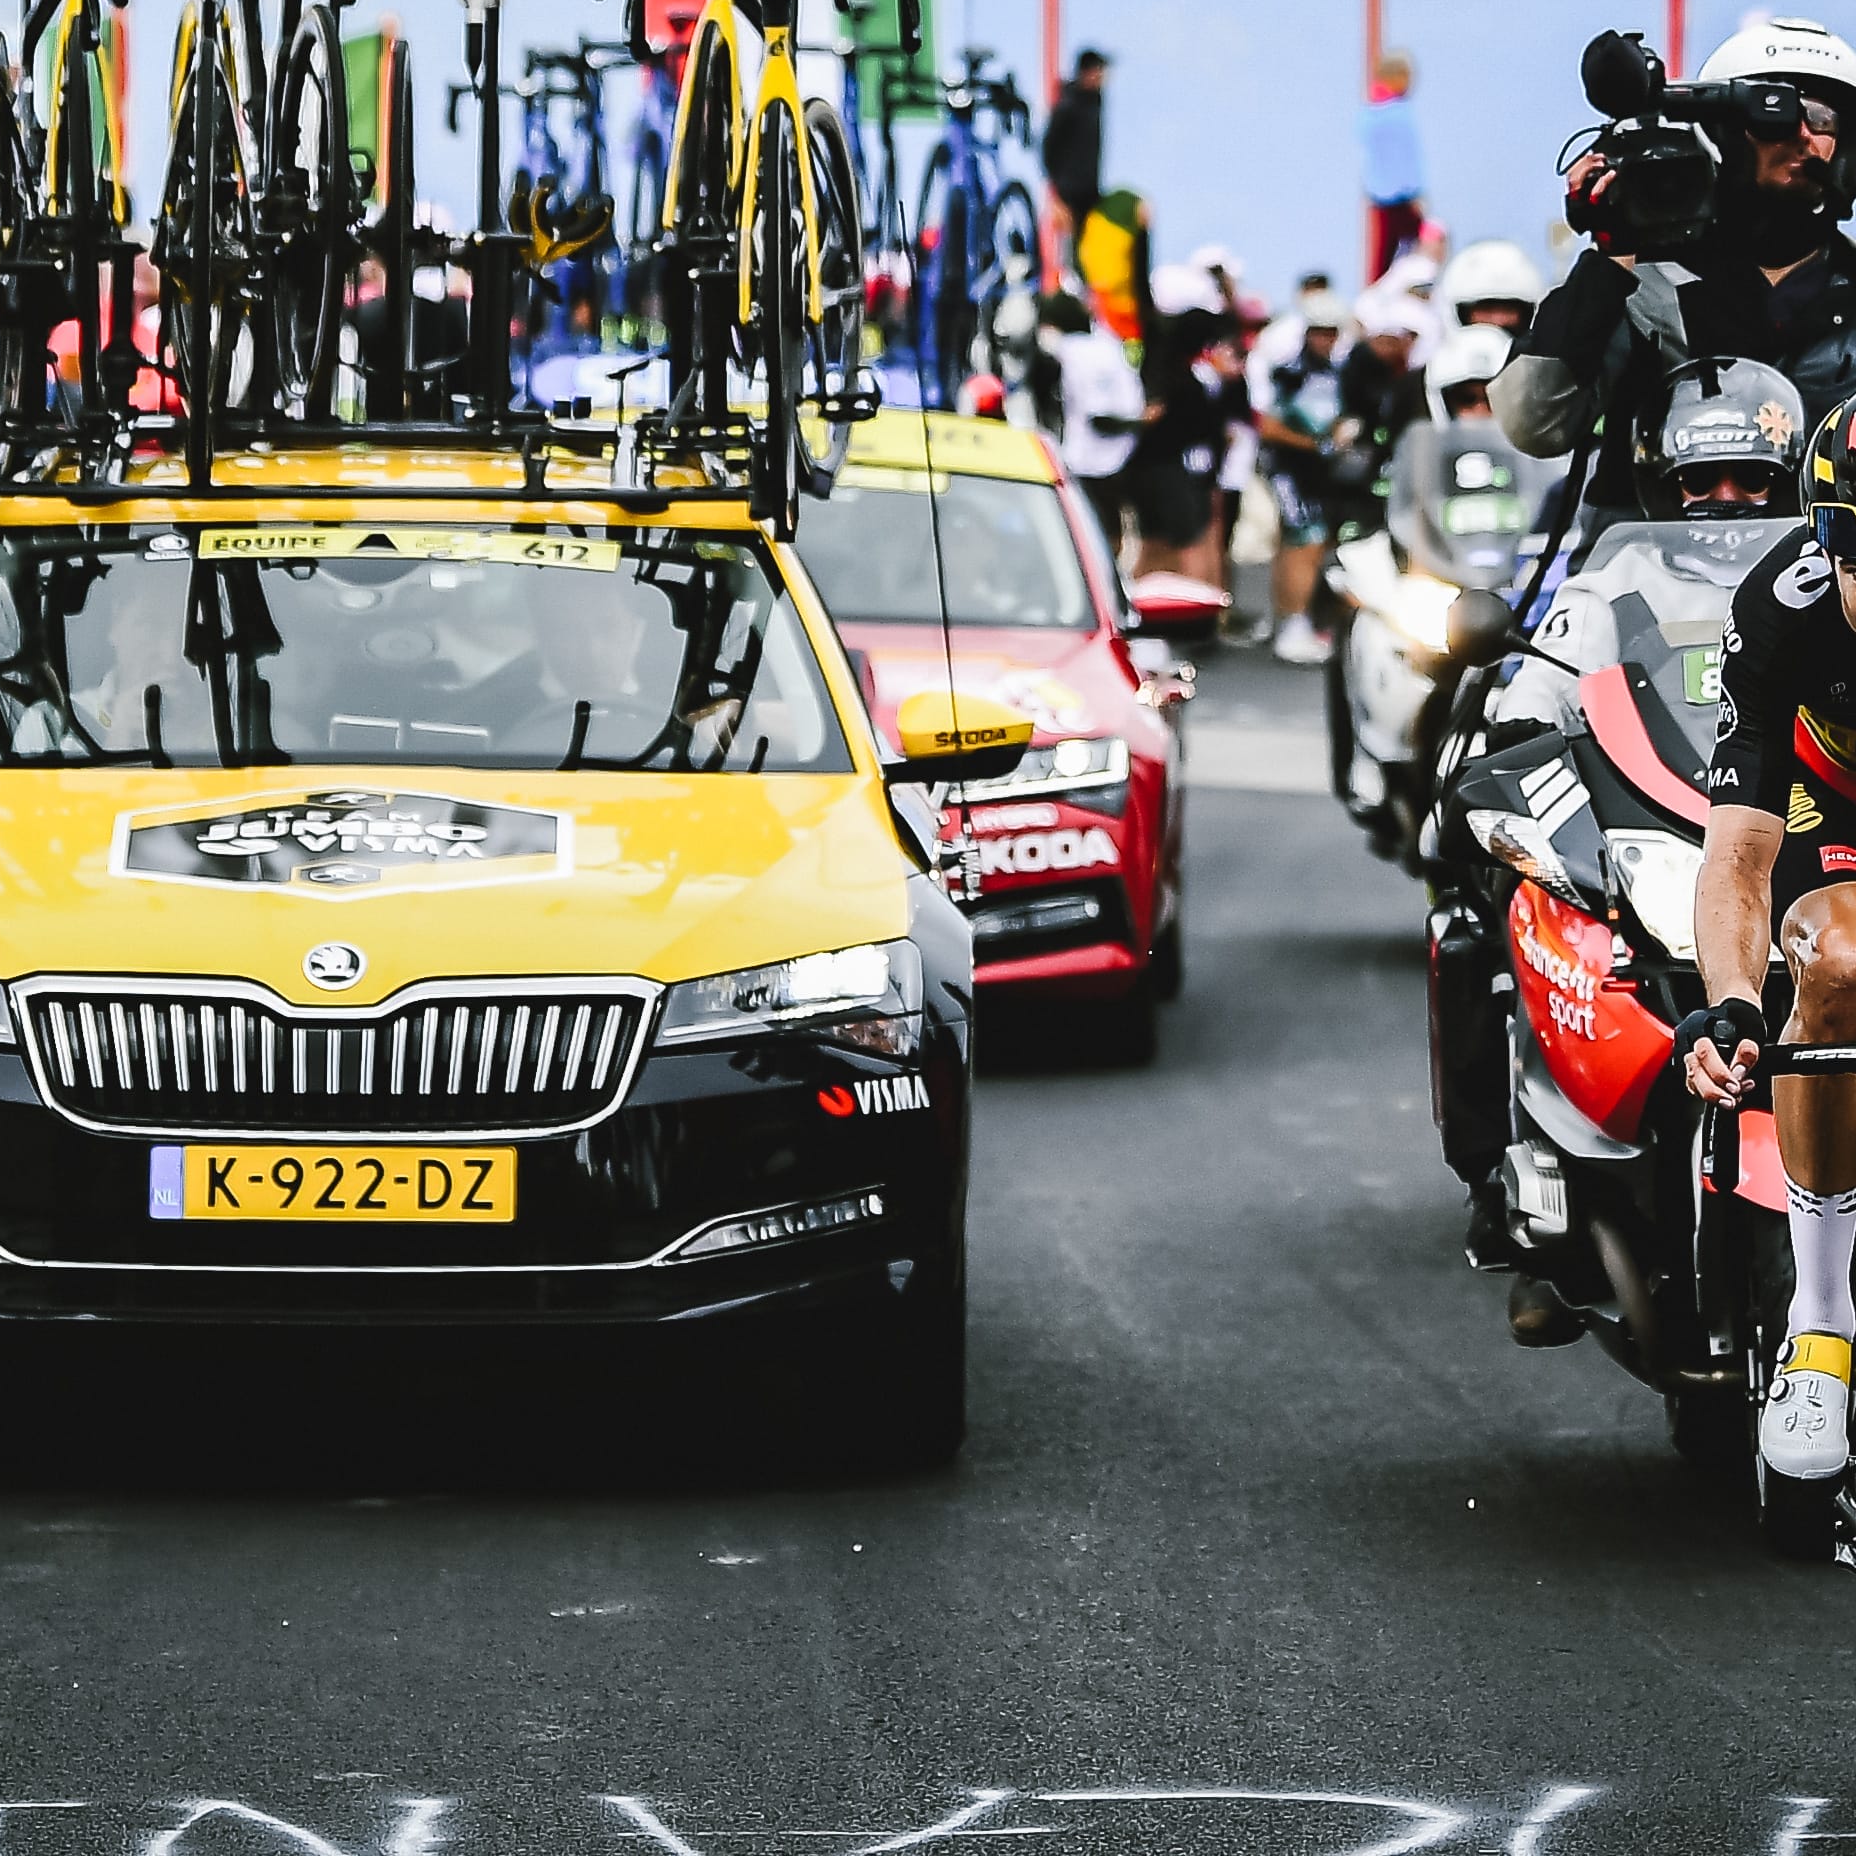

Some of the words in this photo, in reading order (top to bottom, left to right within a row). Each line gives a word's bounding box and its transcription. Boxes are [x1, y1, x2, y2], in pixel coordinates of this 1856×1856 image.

[522, 541, 589, 563] 612
[1708, 767, 1740, 787] MA
[196, 820, 488, 842] JUMBO
[296, 835, 484, 858] VISMA
[1548, 991, 1596, 1040] sport
[853, 1075, 931, 1115] VISMA
[154, 1188, 178, 1207] NL
[207, 1156, 494, 1210] K-922-DZ
